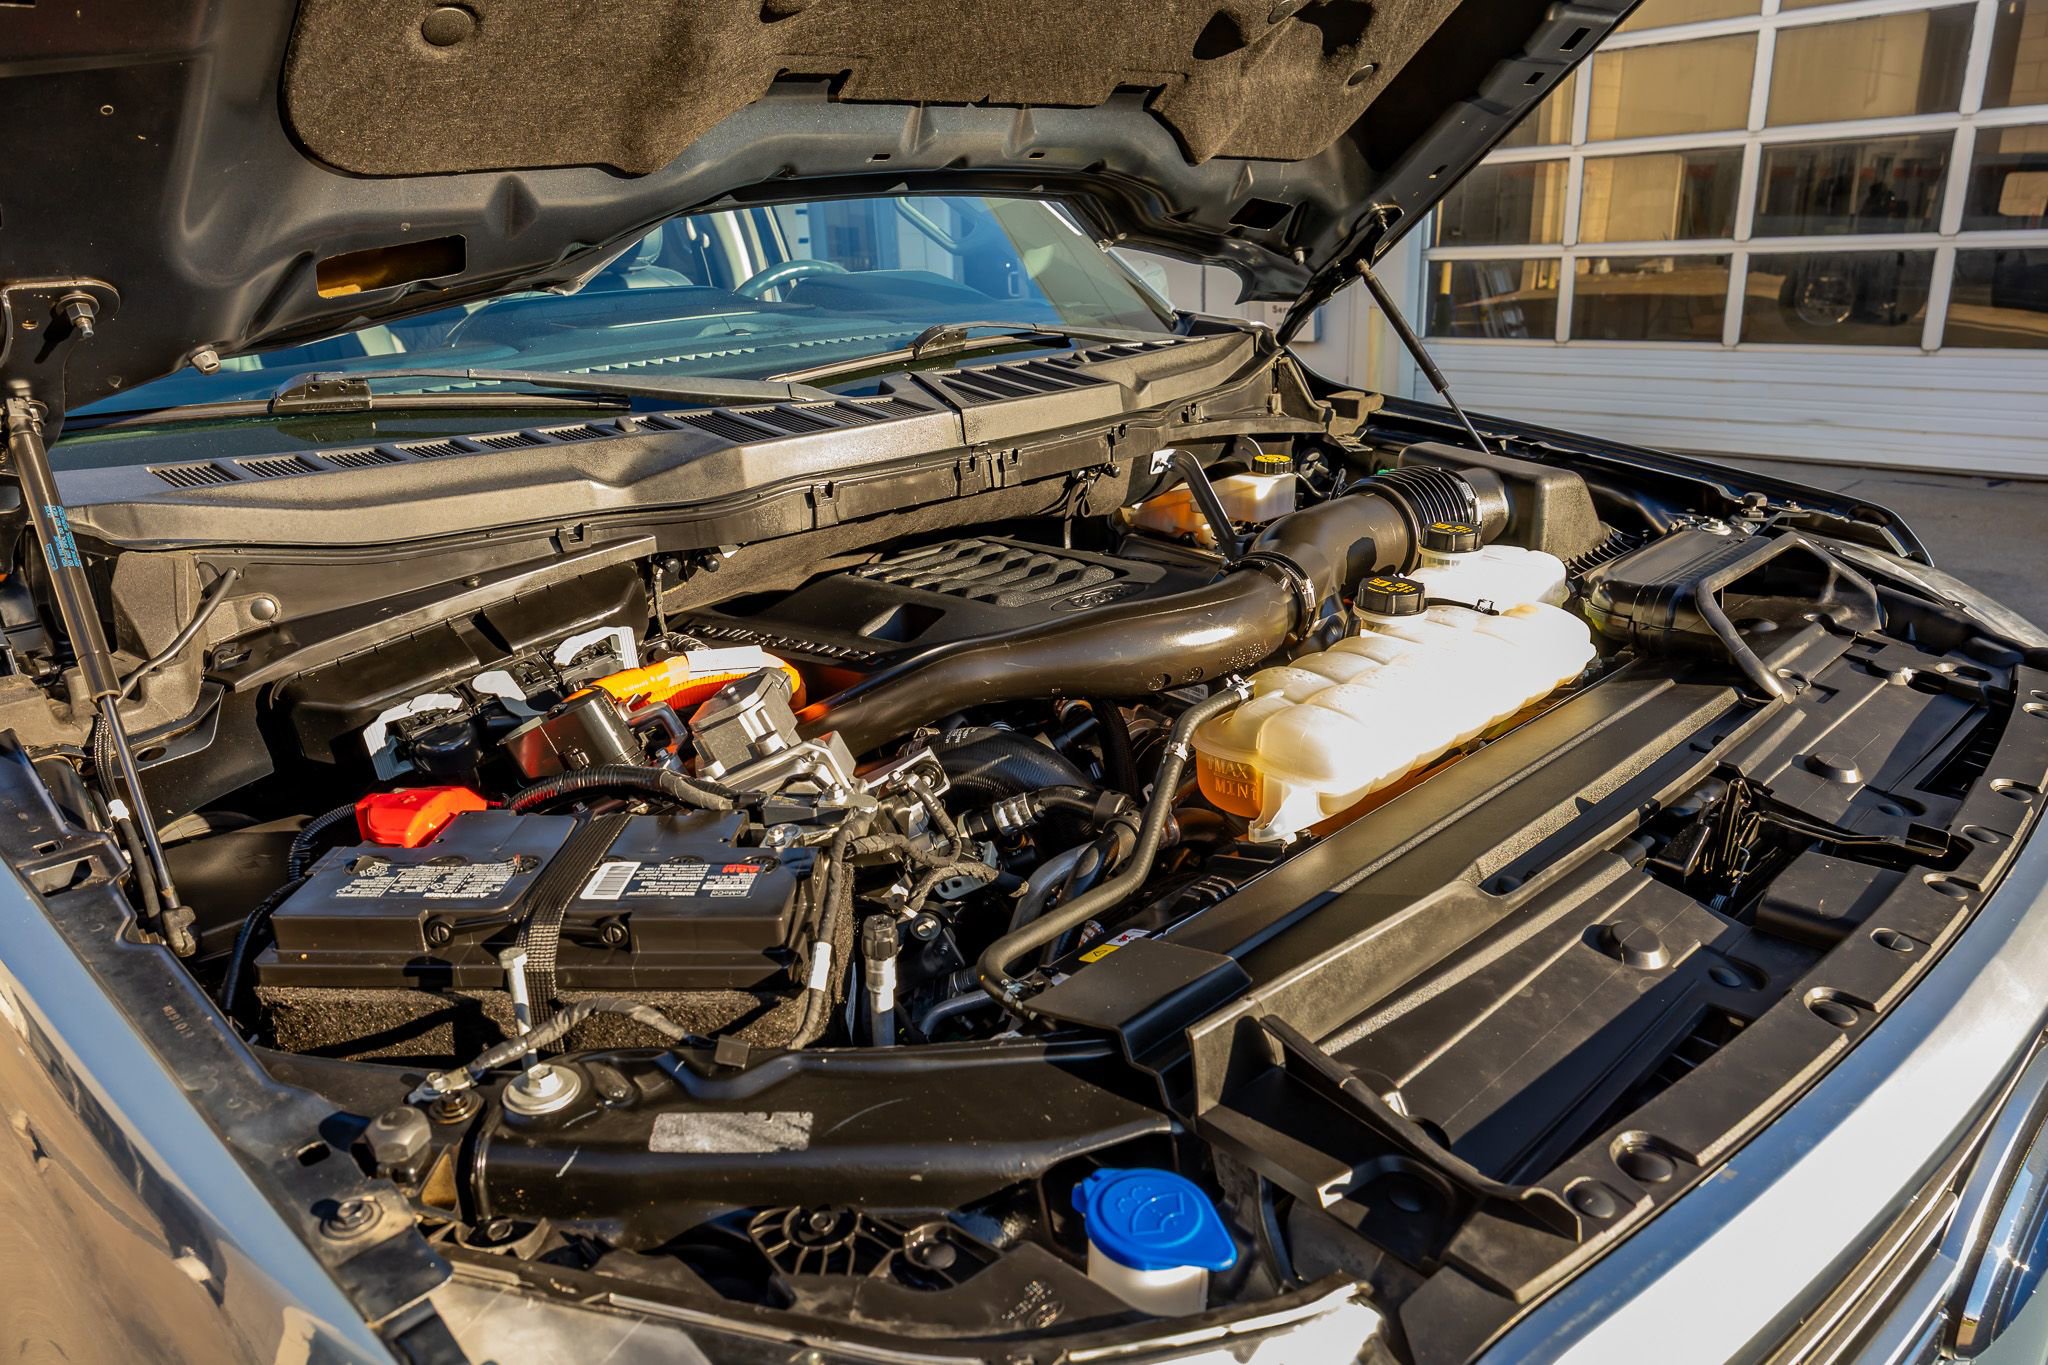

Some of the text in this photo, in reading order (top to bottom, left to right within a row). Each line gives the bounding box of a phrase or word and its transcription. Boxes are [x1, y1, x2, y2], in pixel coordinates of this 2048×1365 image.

[1271, 304, 1289, 314] Ser
[1214, 757, 1249, 779] MAX
[1215, 778, 1248, 799] MIN
[721, 863, 761, 874] AGM
[710, 889, 748, 898] FoMoCo
